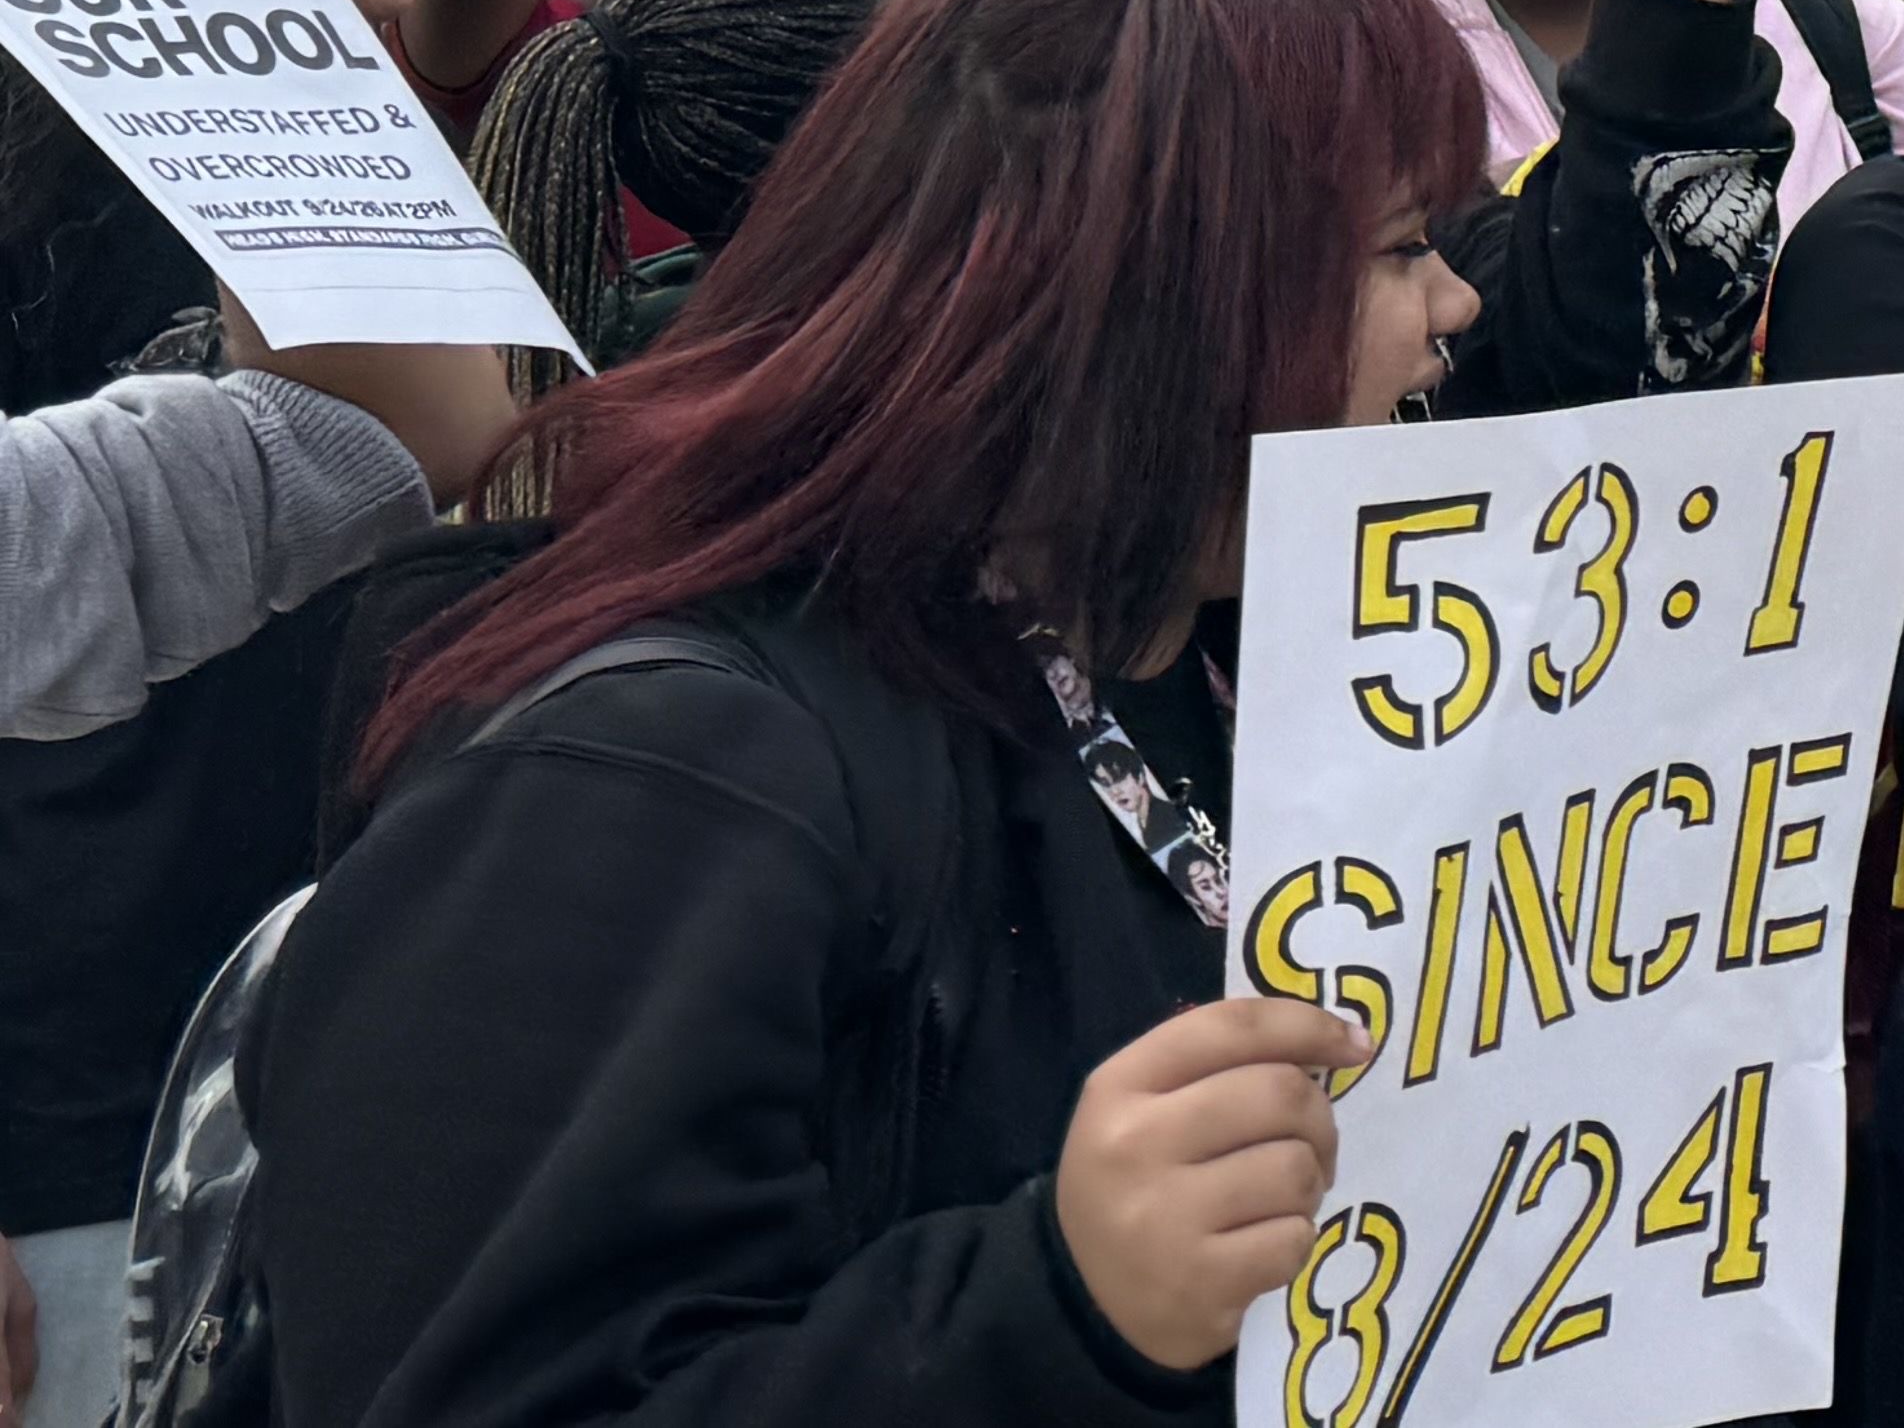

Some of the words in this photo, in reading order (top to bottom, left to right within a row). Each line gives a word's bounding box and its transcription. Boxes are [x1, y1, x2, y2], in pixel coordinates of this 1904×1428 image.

[34, 8, 380, 78] SCHOOL
[103, 105, 381, 138] UNDERSTAFFED
[383, 103, 418, 129] &
[149, 153, 412, 183] OVERCROWDED
[188, 198, 298, 221] WALKOUT
[1352, 429, 1835, 750] 53:1
[1243, 731, 1853, 1103] SINCE
[1283, 1061, 1774, 1428] 8/24
